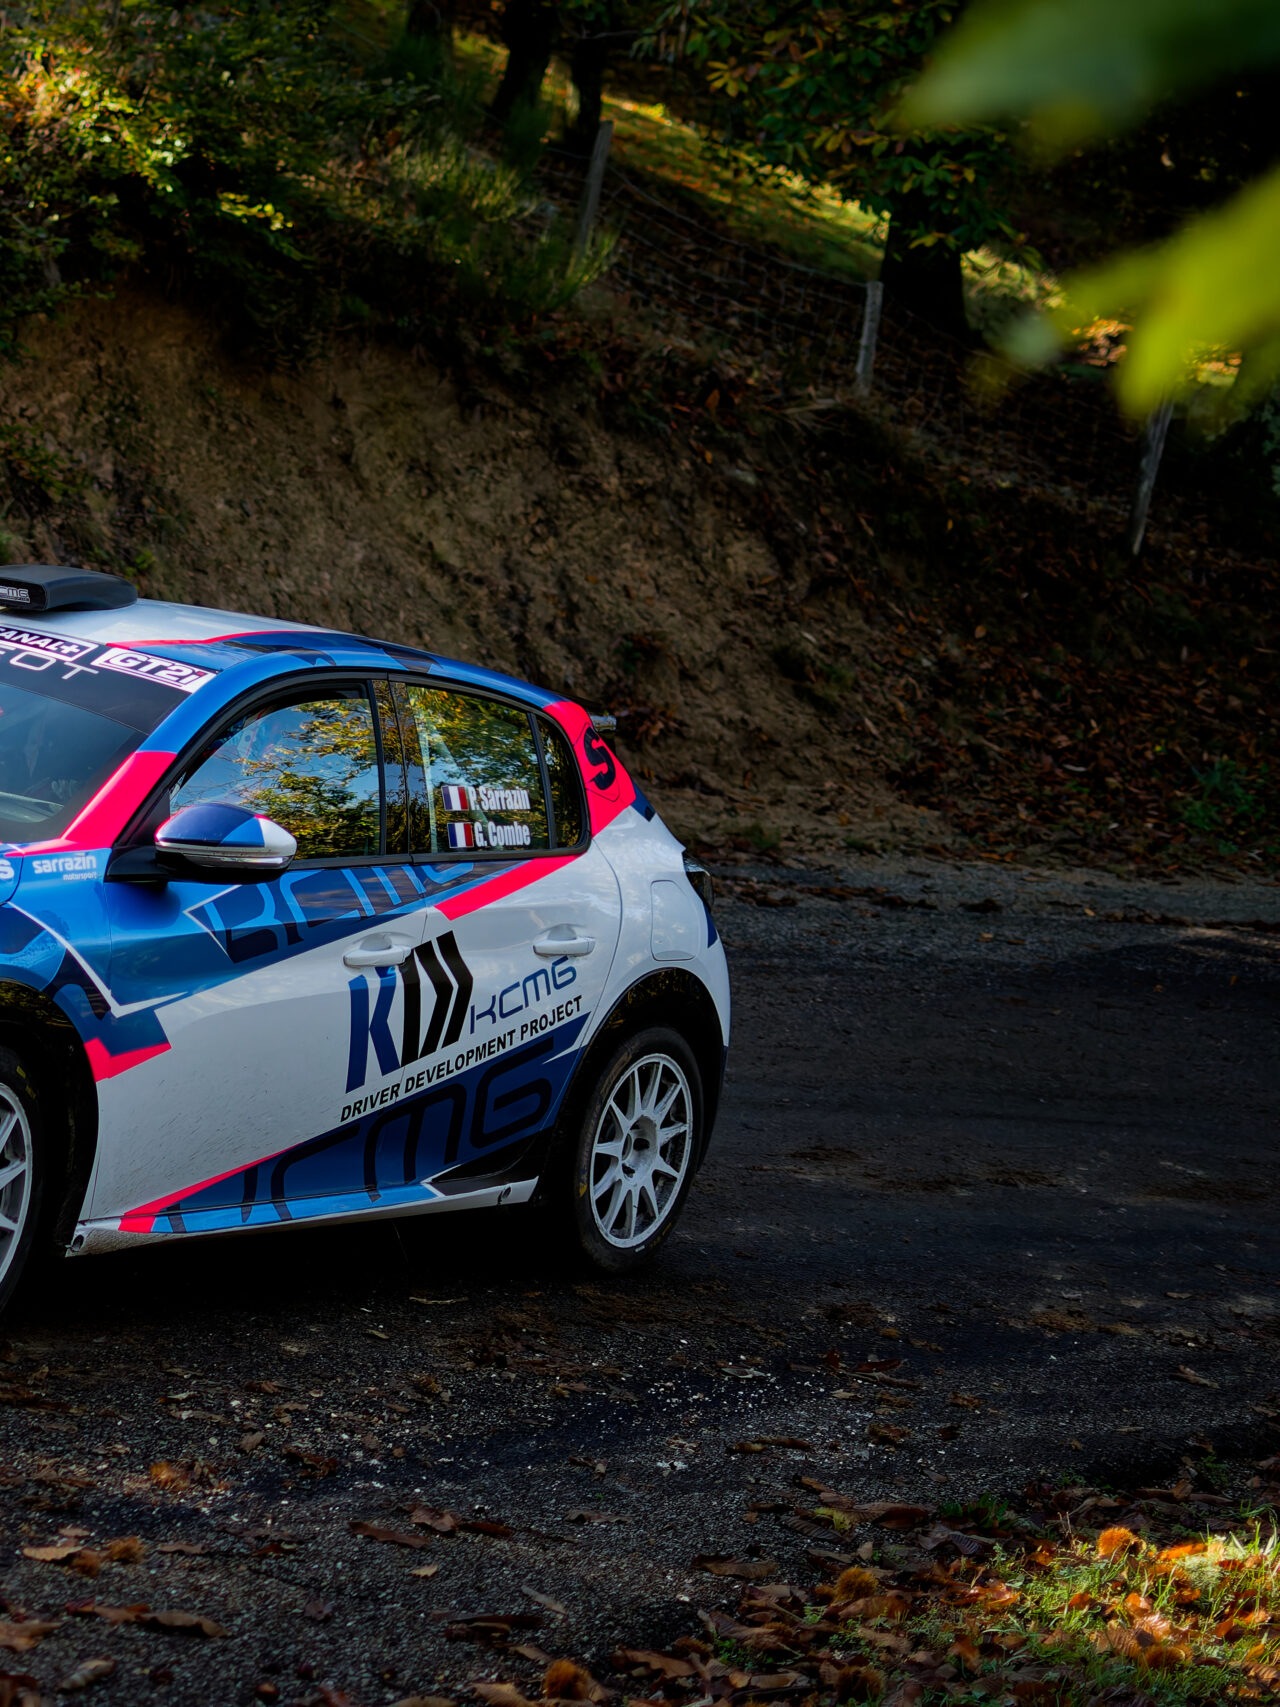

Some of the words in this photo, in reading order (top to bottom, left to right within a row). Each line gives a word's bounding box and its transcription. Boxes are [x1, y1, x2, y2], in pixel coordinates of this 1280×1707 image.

[109, 652, 207, 685] GT2i
[469, 786, 480, 810] P.
[479, 786, 531, 810] Sarrazin
[474, 821, 487, 846] G.
[487, 821, 531, 846] Combe
[32, 853, 97, 875] sarrazin
[62, 871, 98, 881] motorsport
[470, 956, 577, 1035] KCMG
[340, 1084, 401, 1122] DRIVER
[405, 1029, 515, 1093] DEVELOPMENT
[520, 995, 583, 1041] PROJECT
